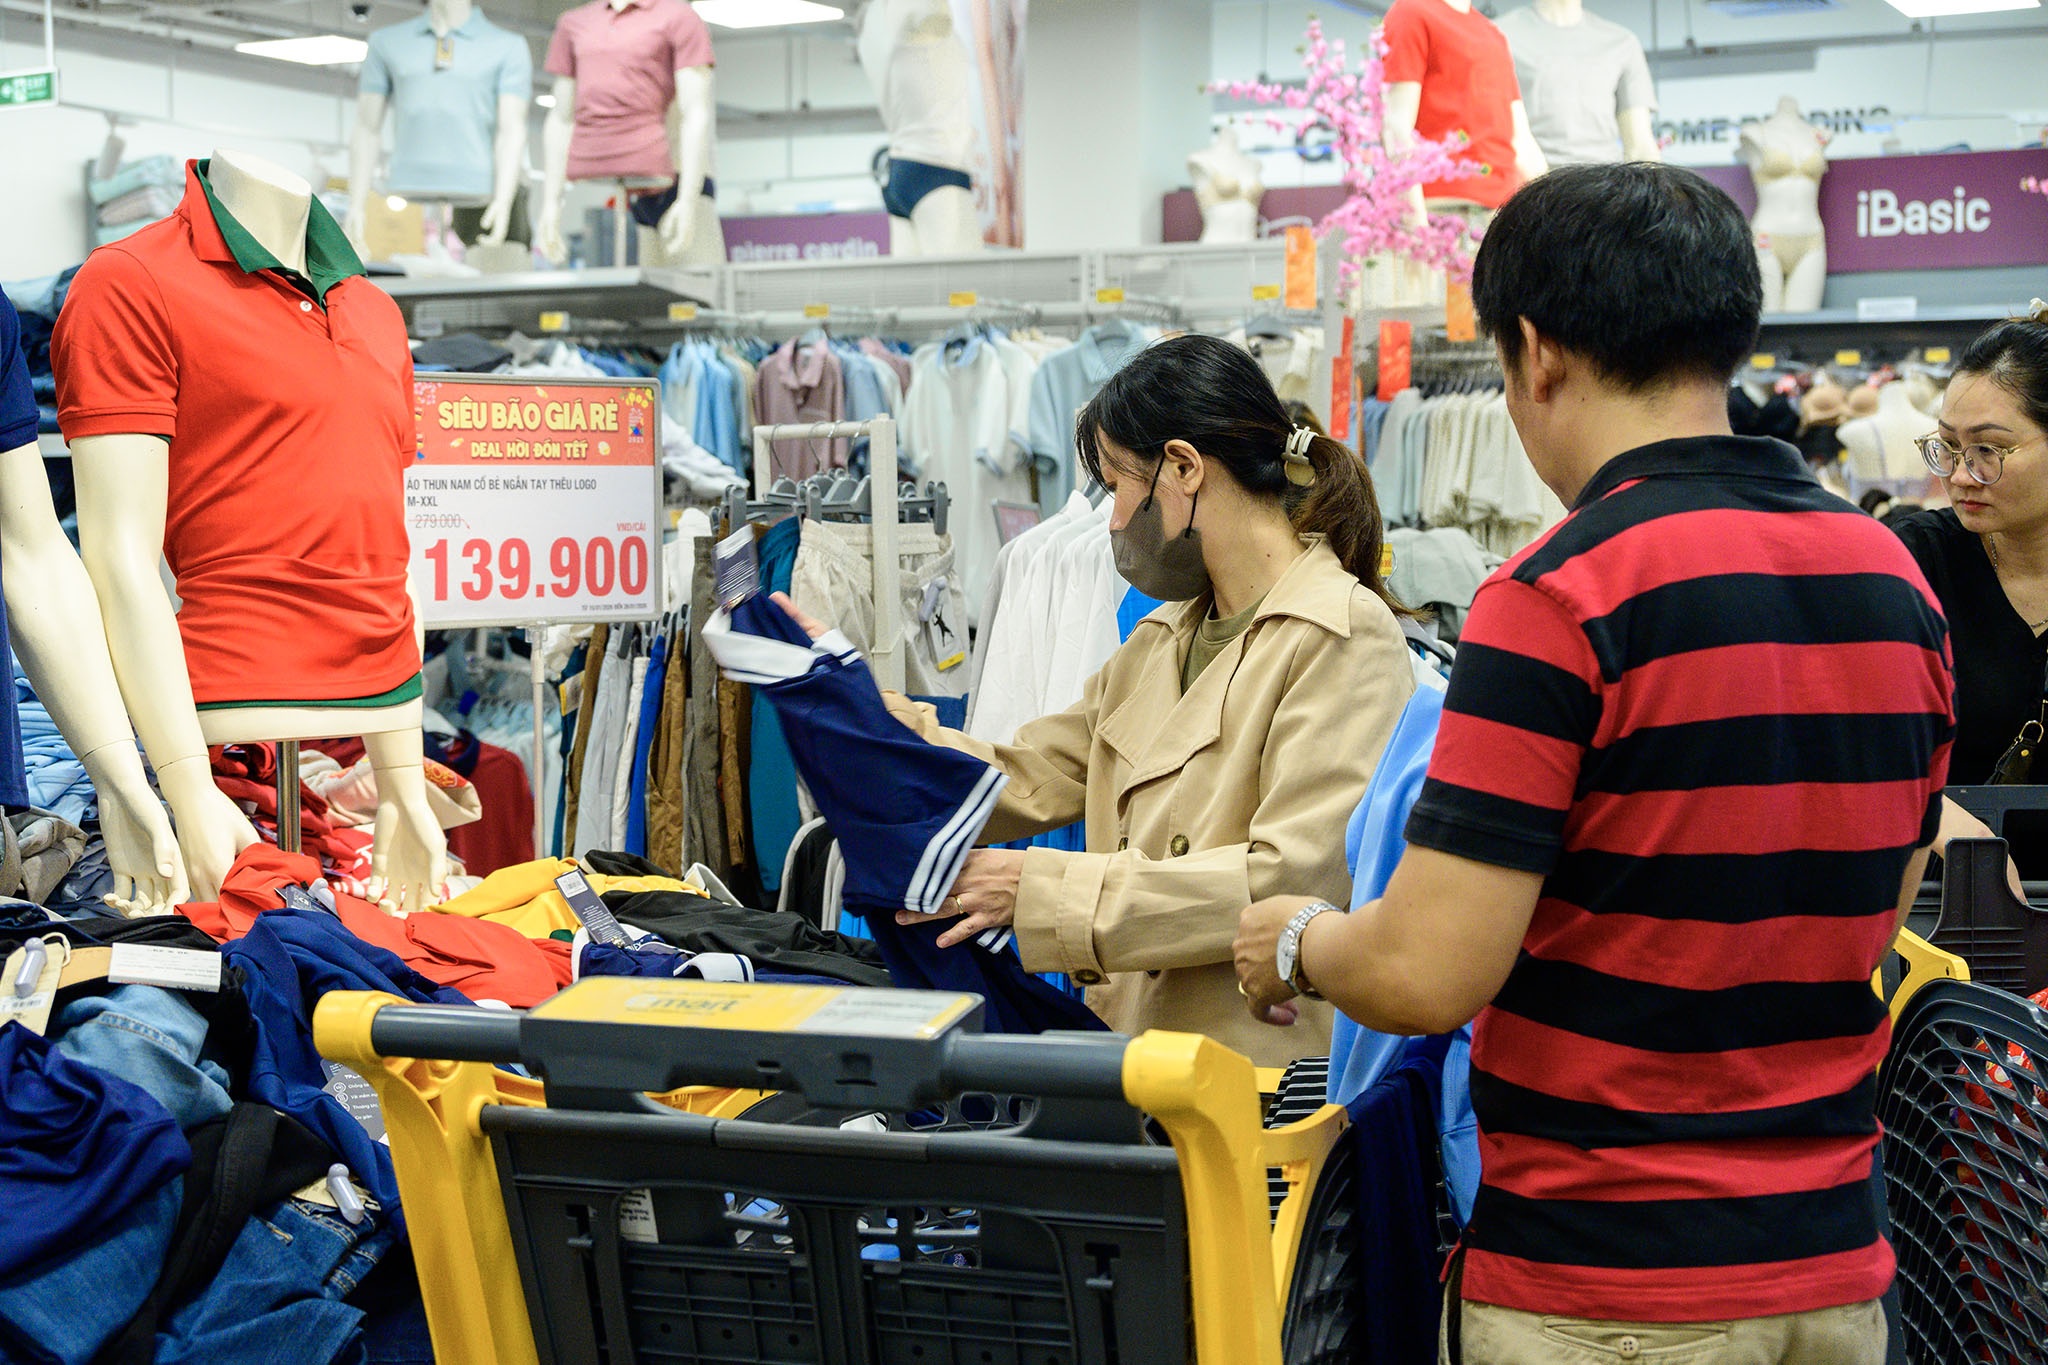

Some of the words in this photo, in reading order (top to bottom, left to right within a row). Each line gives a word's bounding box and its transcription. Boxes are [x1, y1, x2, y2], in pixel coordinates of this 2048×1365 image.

[1653, 117, 1729, 144] OME
[1856, 185, 1992, 238] iBasic
[730, 240, 798, 262] pierre
[802, 236, 879, 260] cardin
[438, 396, 488, 430] SIÊU
[491, 397, 542, 431] BÃO
[544, 397, 588, 431] GIÁ
[589, 398, 619, 432] RẺ
[471, 441, 503, 458] DEAL
[533, 438, 561, 458] ĐÓN
[563, 439, 589, 459] TẾT
[423, 479, 448, 490] THUN
[450, 479, 472, 490] NAM
[530, 479, 548, 490] TAY
[550, 476, 572, 490] THÊU
[574, 479, 597, 490] LOGO
[407, 496, 438, 507] M-XXL
[415, 513, 462, 528] 279.000
[424, 535, 648, 601] 139.900
